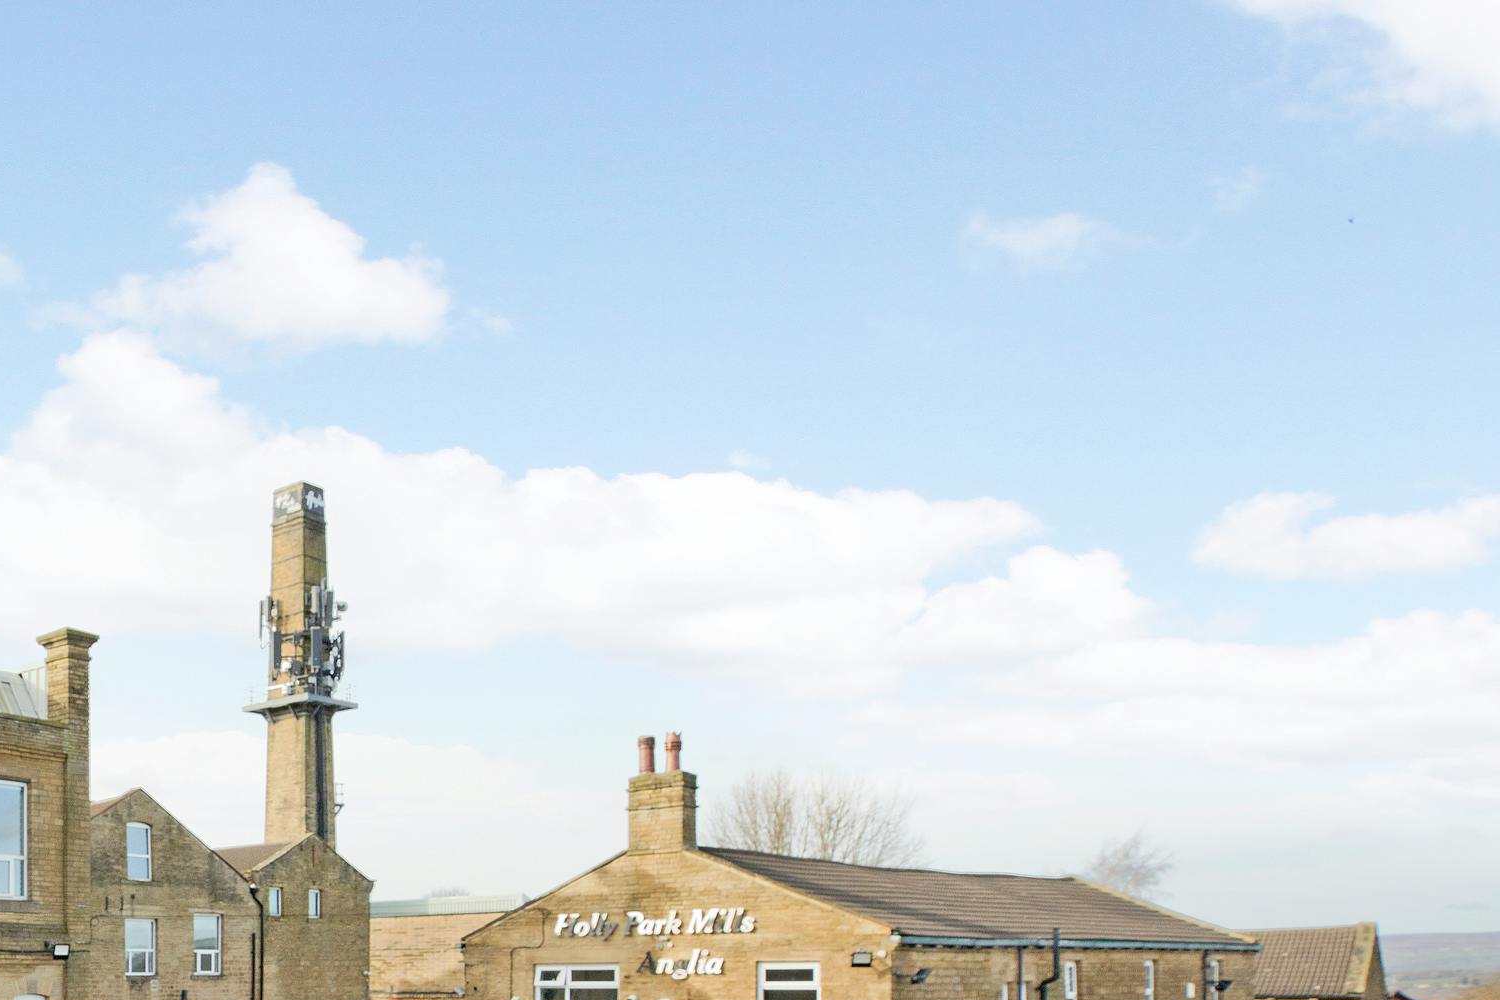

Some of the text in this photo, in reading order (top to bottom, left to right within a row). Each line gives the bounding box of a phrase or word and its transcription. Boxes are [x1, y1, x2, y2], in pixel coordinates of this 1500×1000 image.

[554, 907, 756, 941] Holly Park Mills
[636, 948, 724, 980] Anglia
